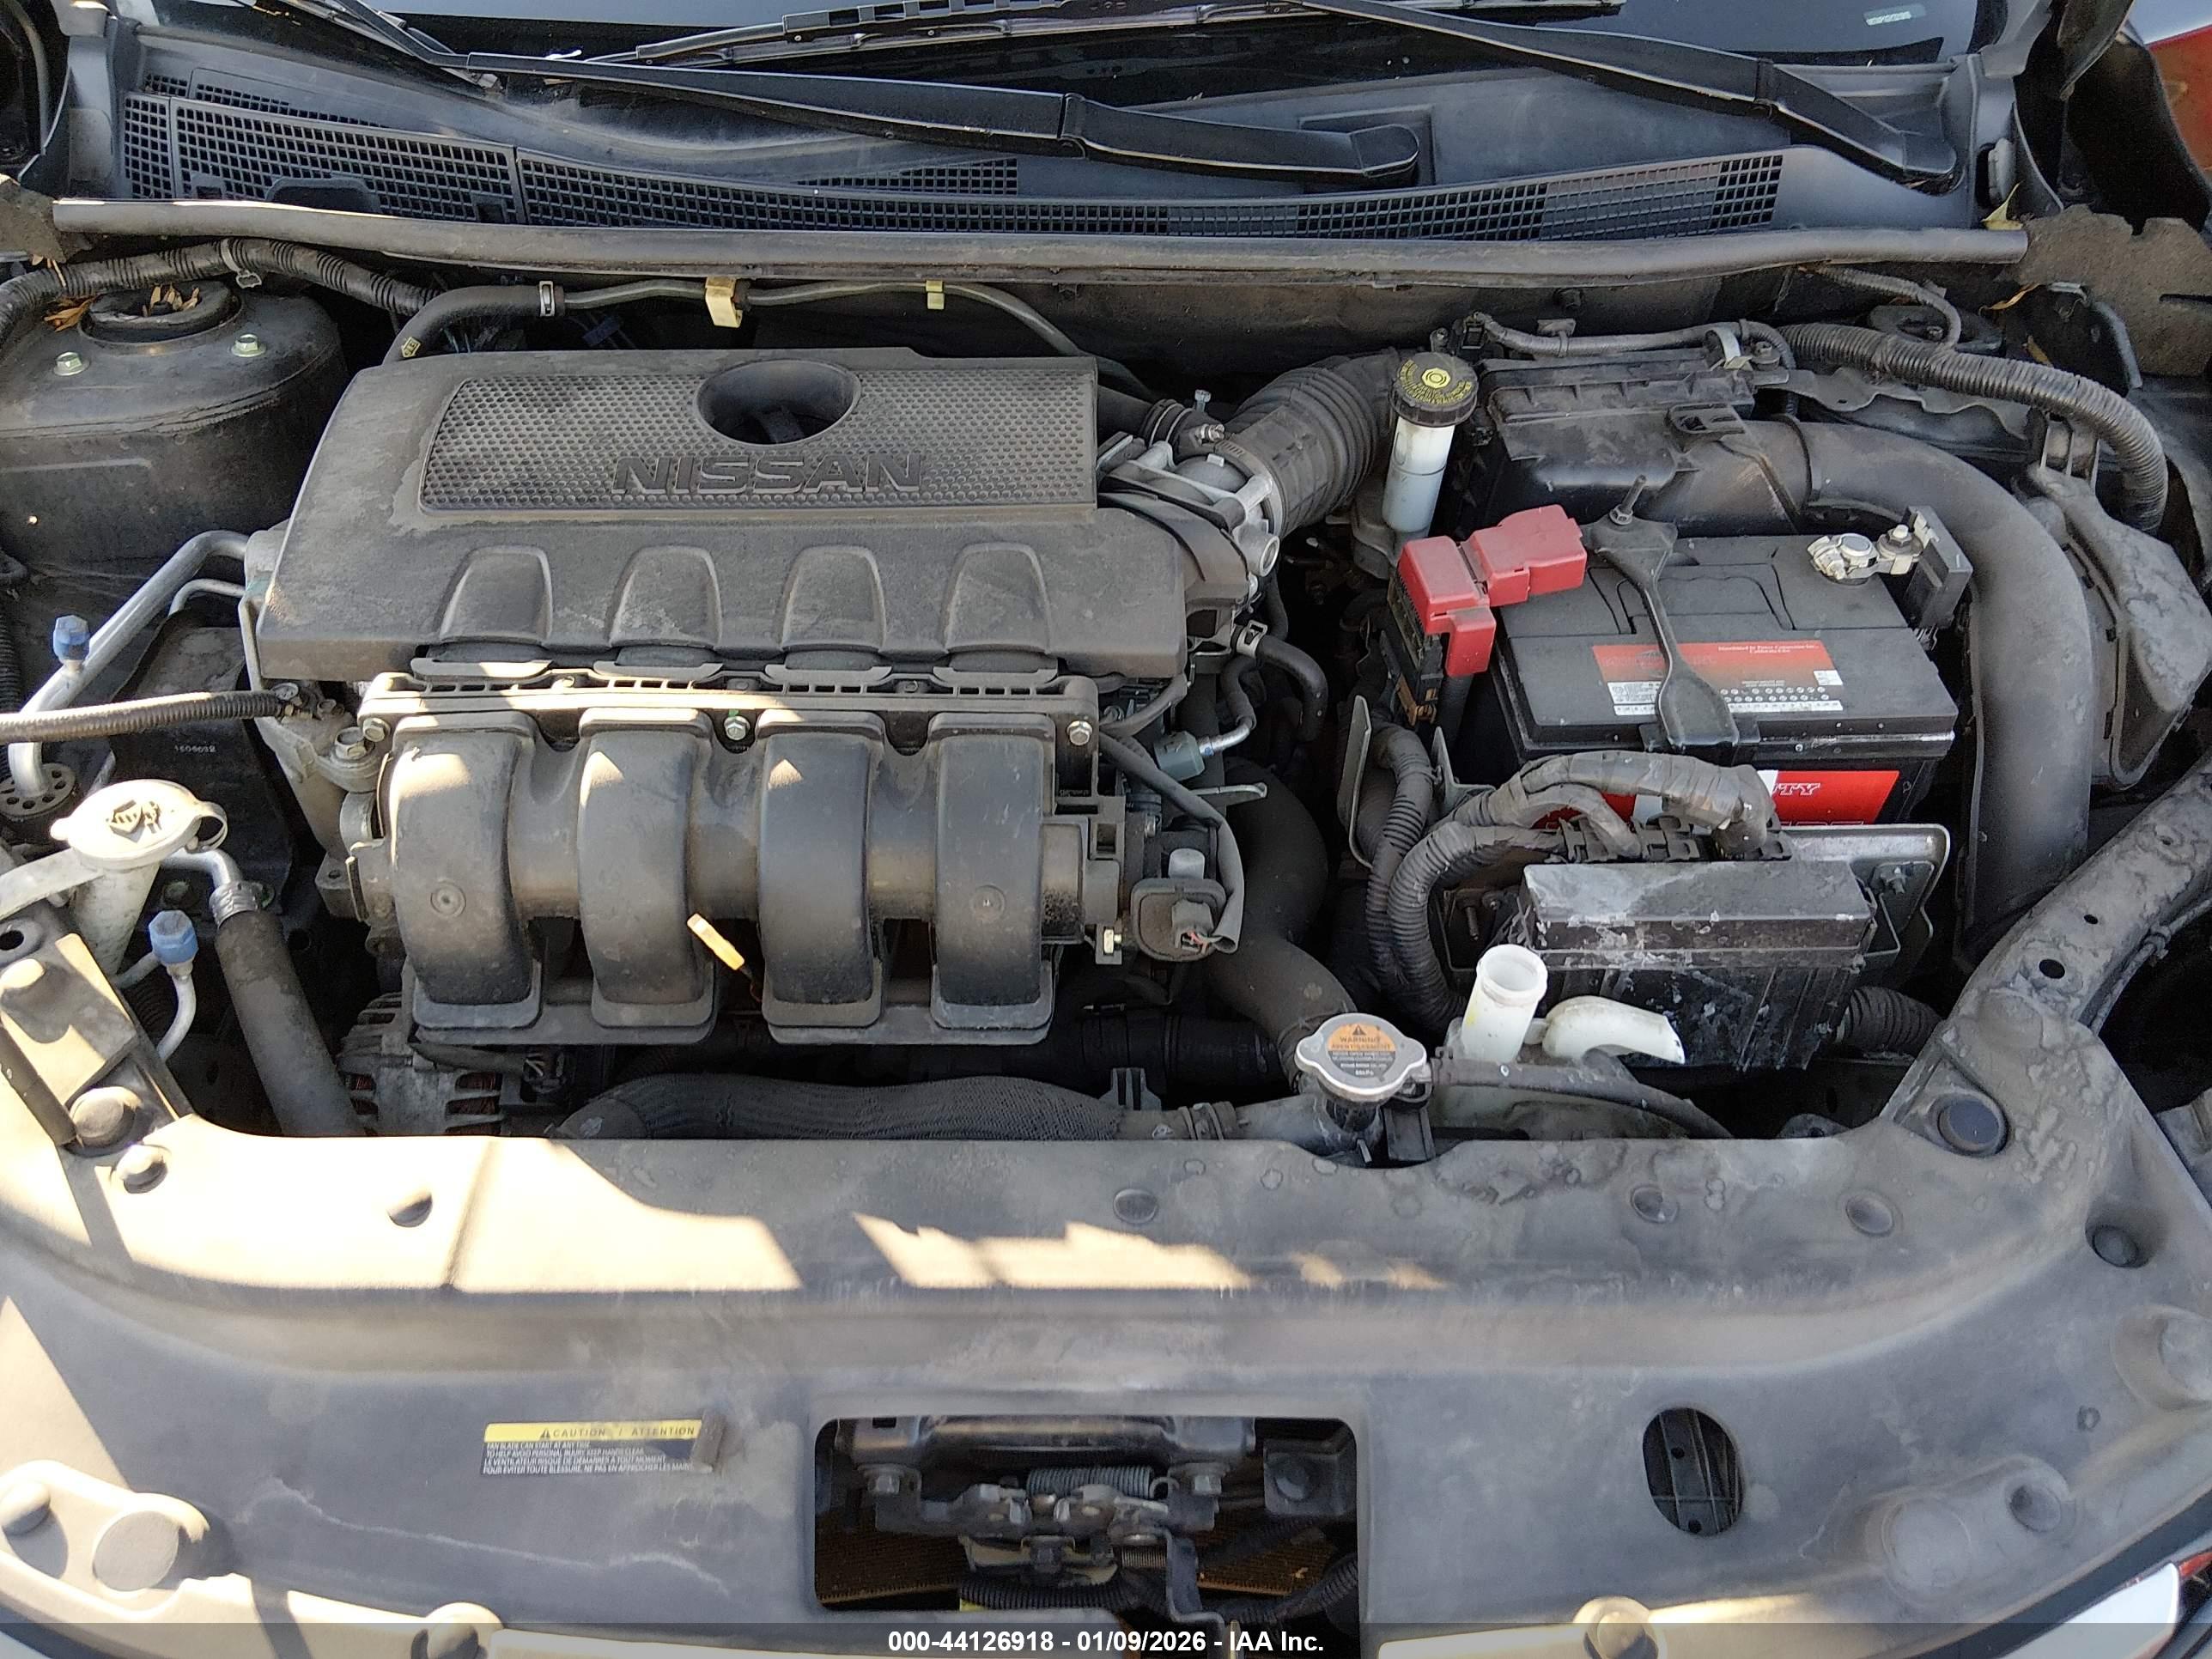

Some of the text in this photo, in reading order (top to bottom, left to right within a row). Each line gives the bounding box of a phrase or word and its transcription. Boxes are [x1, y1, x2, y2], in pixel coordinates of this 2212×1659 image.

[612, 454, 921, 494] NISSAN
[552, 1428, 605, 1438] CAUTION
[631, 1426, 695, 1437] ATTENTION
